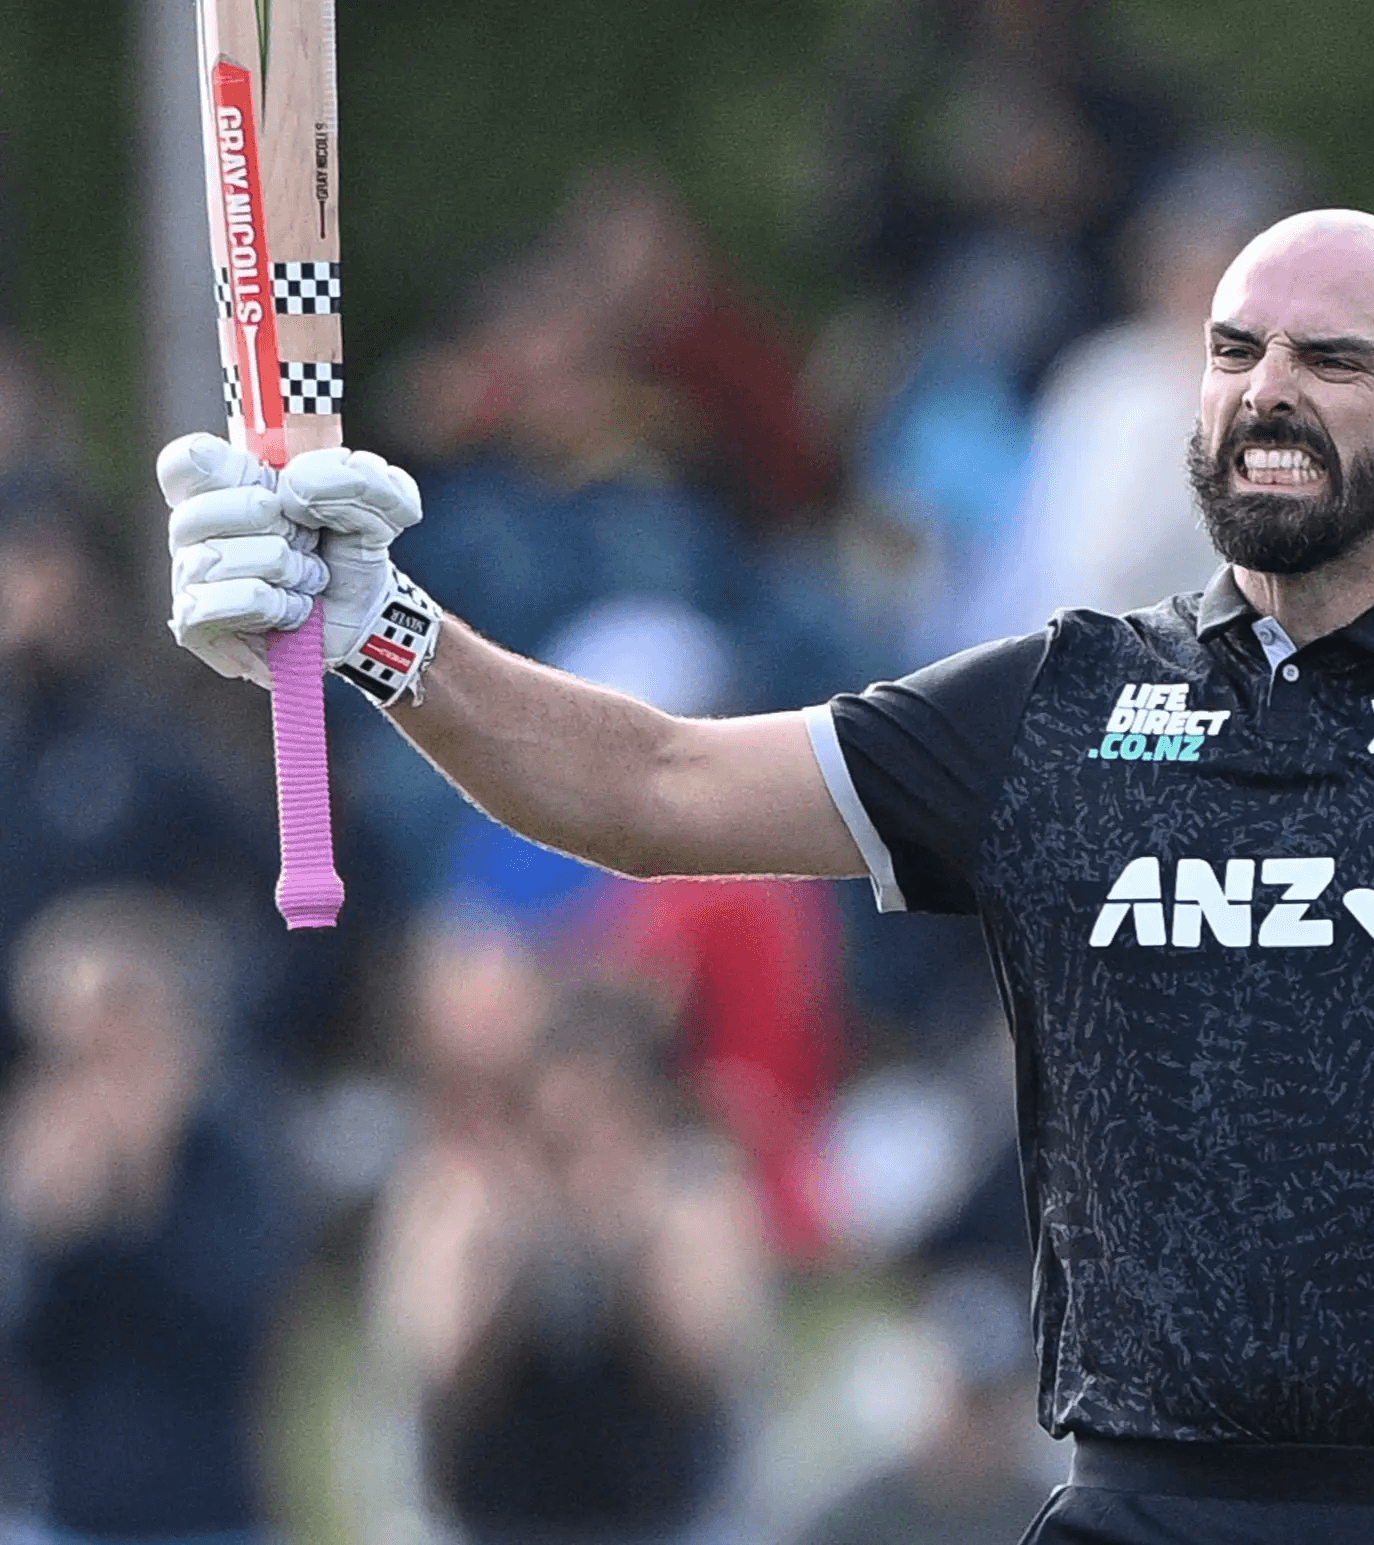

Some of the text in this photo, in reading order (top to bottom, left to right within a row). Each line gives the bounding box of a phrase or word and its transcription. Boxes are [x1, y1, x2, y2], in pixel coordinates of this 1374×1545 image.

[1116, 683, 1189, 711] LIFE
[1106, 708, 1231, 736] DIRECT
[1088, 733, 1205, 762] .CO.NZ
[1089, 856, 1335, 948] ANZ
